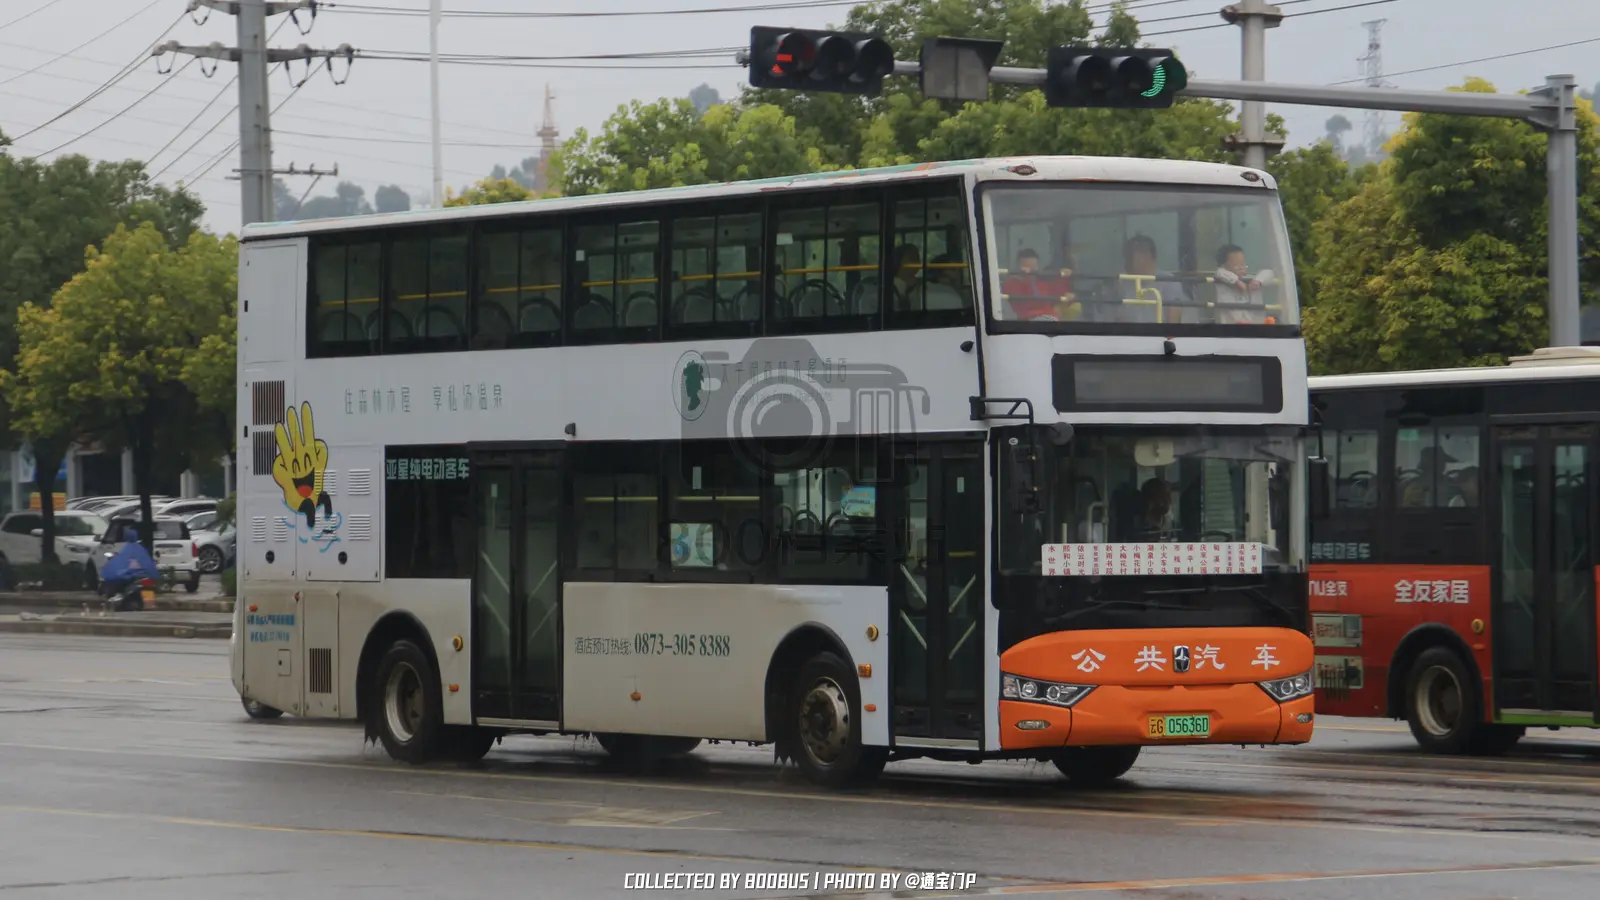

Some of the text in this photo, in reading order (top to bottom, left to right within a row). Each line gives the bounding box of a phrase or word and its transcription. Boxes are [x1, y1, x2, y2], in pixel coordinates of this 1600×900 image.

[386, 458, 470, 480] 亚星纯电动客车
[1394, 579, 1470, 604] 全友家居
[699, 634, 731, 657] 8388
